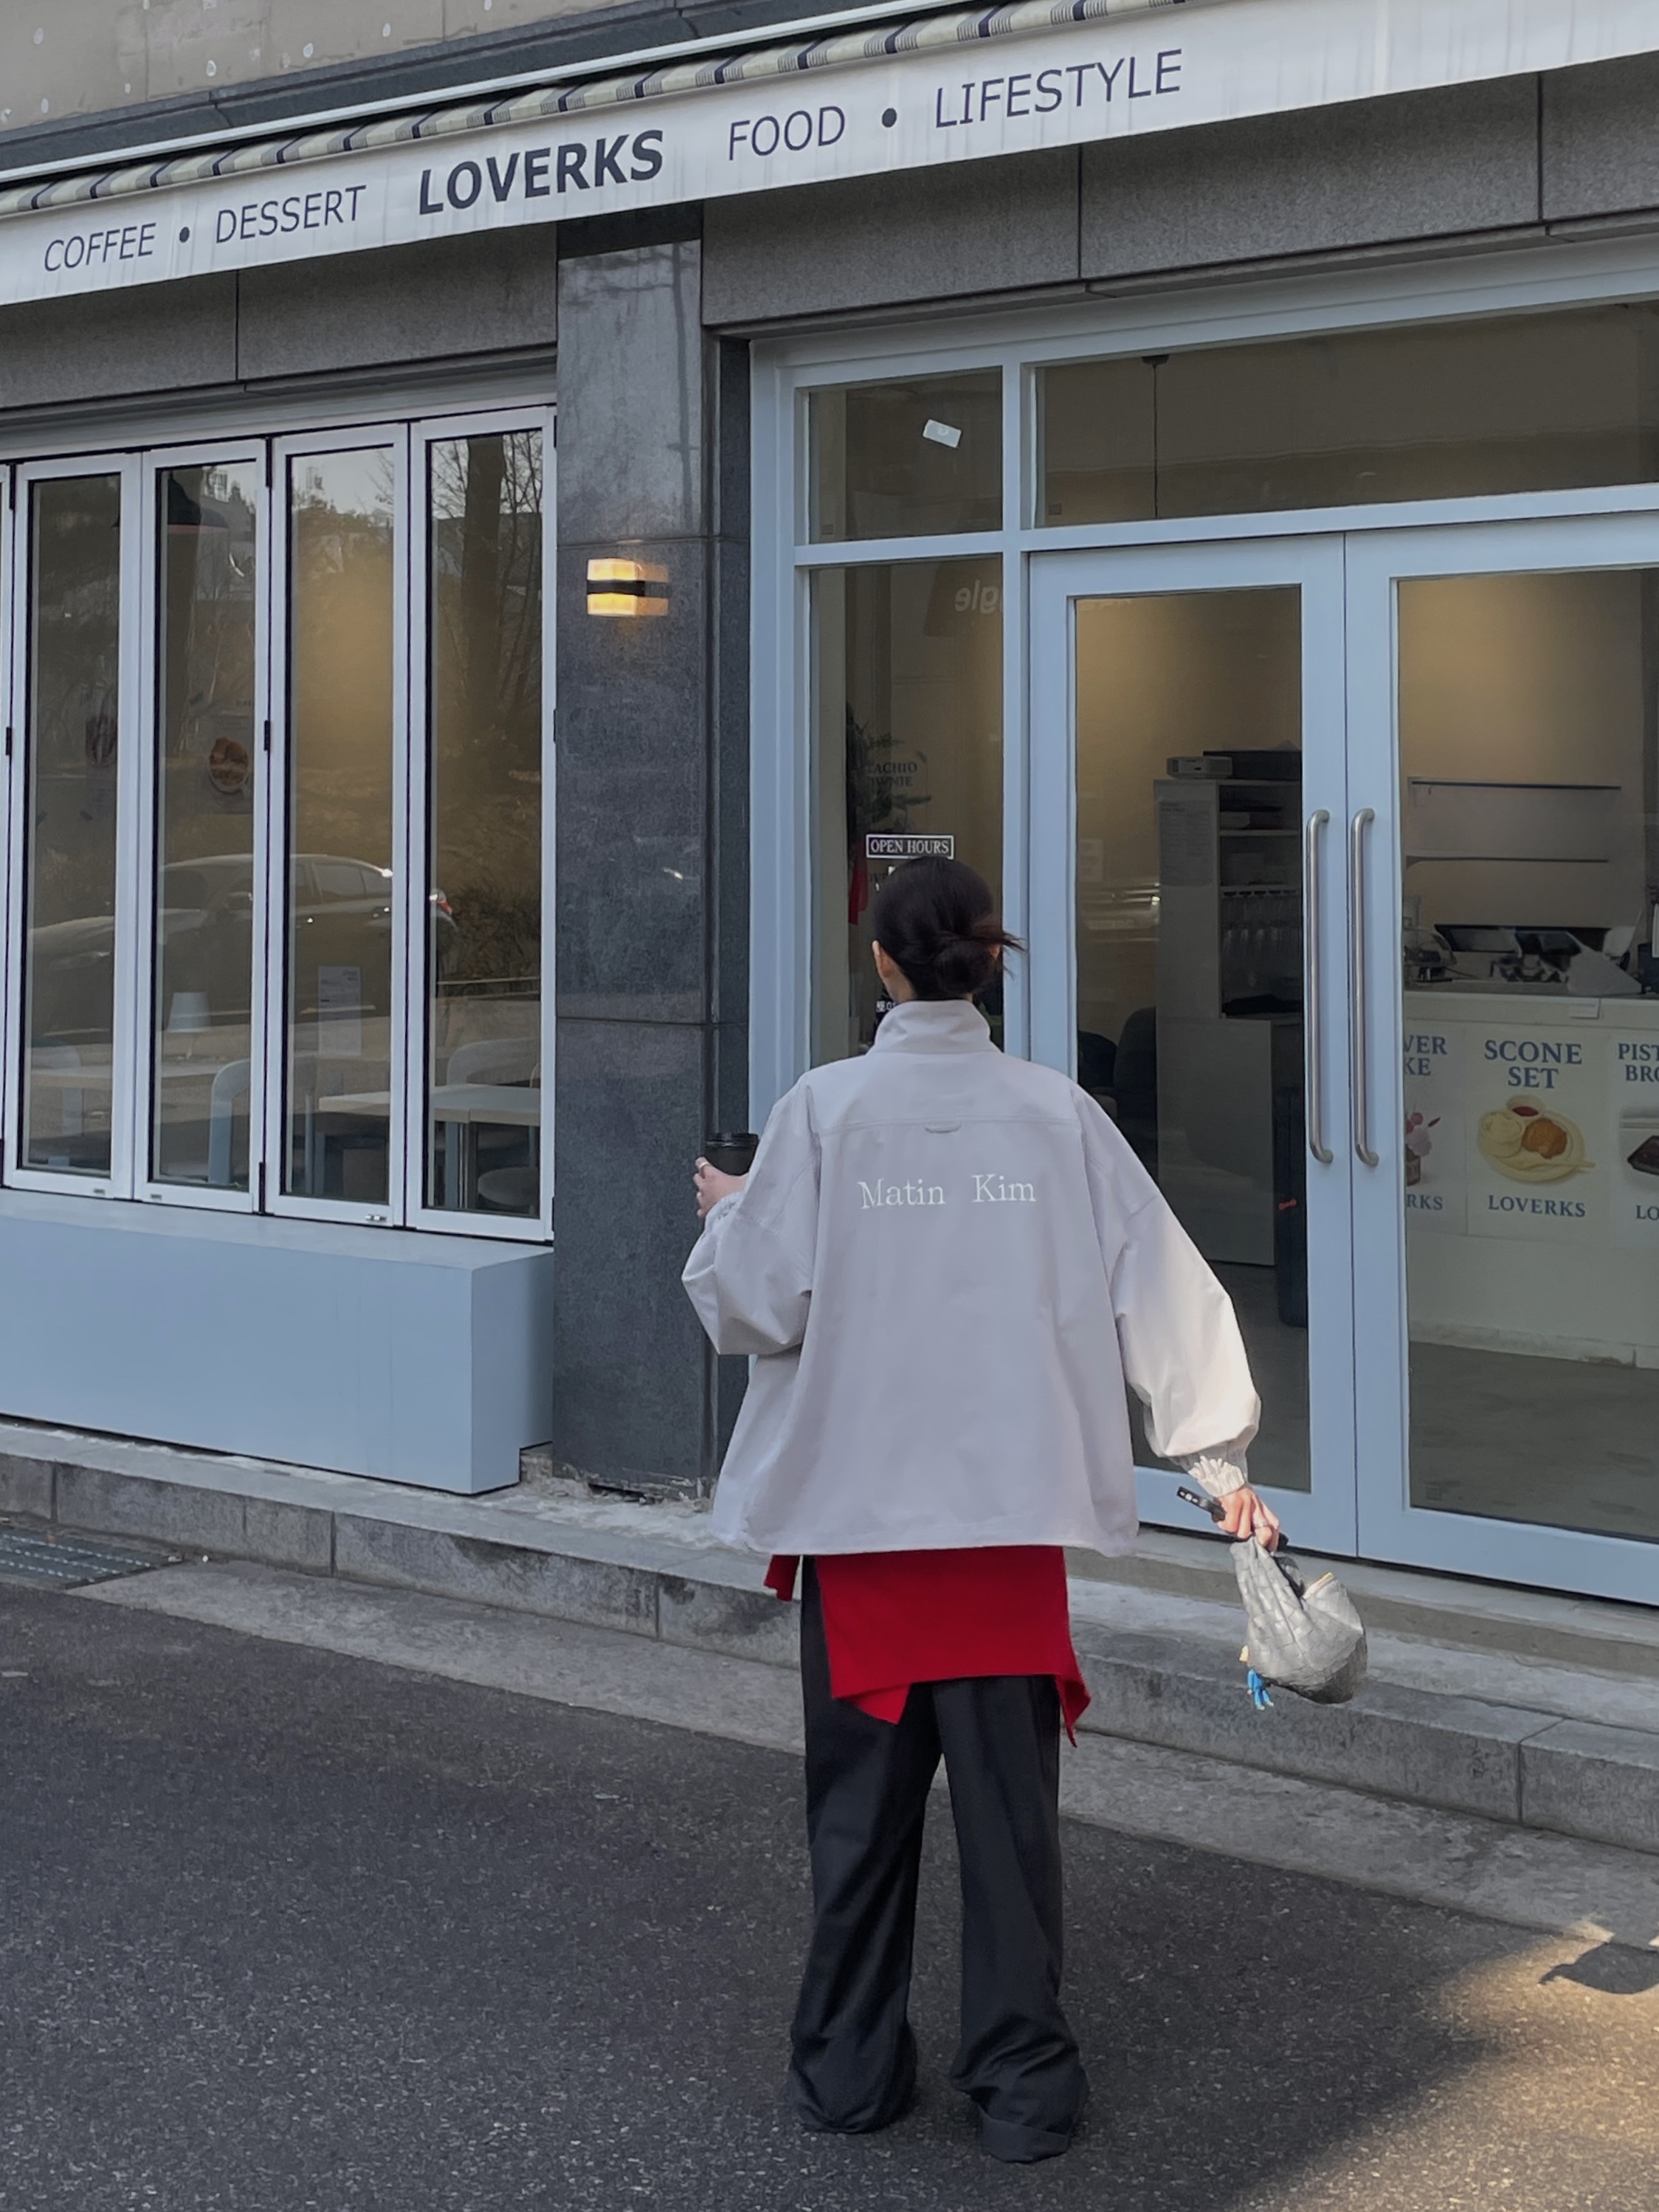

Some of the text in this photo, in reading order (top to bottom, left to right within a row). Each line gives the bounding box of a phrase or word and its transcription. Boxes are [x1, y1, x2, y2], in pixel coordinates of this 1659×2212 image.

[43, 47, 1183, 272] COFFEE DESSERT LOVERKS FOOD LIFESTYLE
[870, 839, 949, 855] OPEN HOURS
[1484, 1039, 1582, 1064] SCONE
[1507, 1066, 1559, 1089] SET
[857, 1174, 1036, 1209] Matin Kim
[1488, 1194, 1586, 1219] LOVERKS
